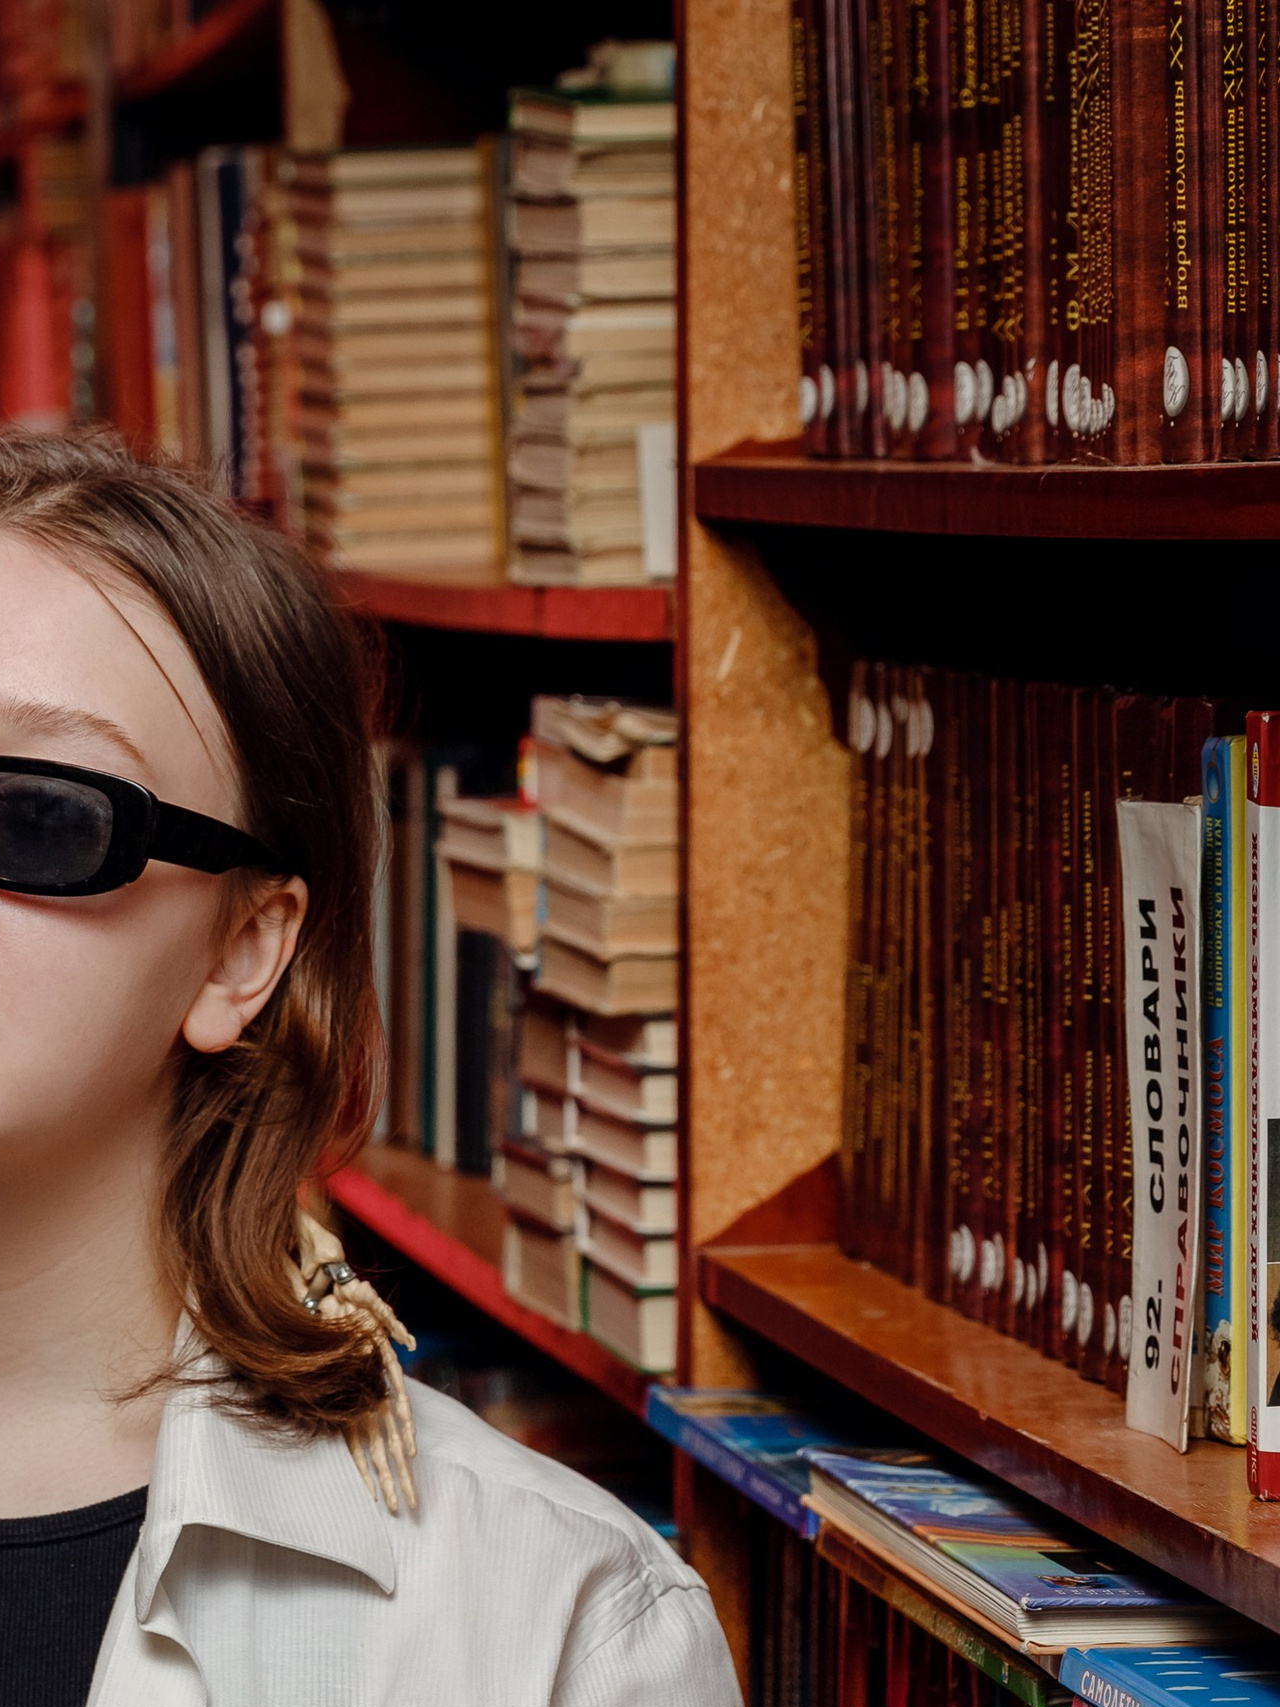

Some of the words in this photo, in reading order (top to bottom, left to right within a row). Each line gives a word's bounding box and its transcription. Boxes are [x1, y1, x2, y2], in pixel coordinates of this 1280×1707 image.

[1169, 14, 1184, 71] XX
[1222, 43, 1236, 102] XIX
[1174, 79, 1187, 211] половины
[1226, 107, 1237, 226] половины
[1237, 104, 1247, 222] половины
[1259, 97, 1268, 214] половины
[1172, 218, 1192, 310] второй
[1225, 231, 1238, 315] первой
[1238, 230, 1250, 313] первой
[1082, 790, 1094, 875] целина
[1214, 817, 1223, 887] ОТВЕТАХ
[1081, 882, 1094, 1001] Поднятая
[1215, 892, 1223, 903] И
[1215, 908, 1224, 993] ВОПРОСАХ
[1215, 997, 1224, 1008] В
[1138, 896, 1165, 1214] СЛОВАРИ
[1081, 1050, 1094, 1167] Шолохов
[1170, 885, 1190, 1396] СПРАВОЧНИКИ
[1205, 1035, 1225, 1211] КОСМОСА
[1206, 1218, 1225, 1299] МИР
[1250, 1243, 1259, 1344] ДЕТЕЙ
[1144, 1281, 1163, 1371] 92.
